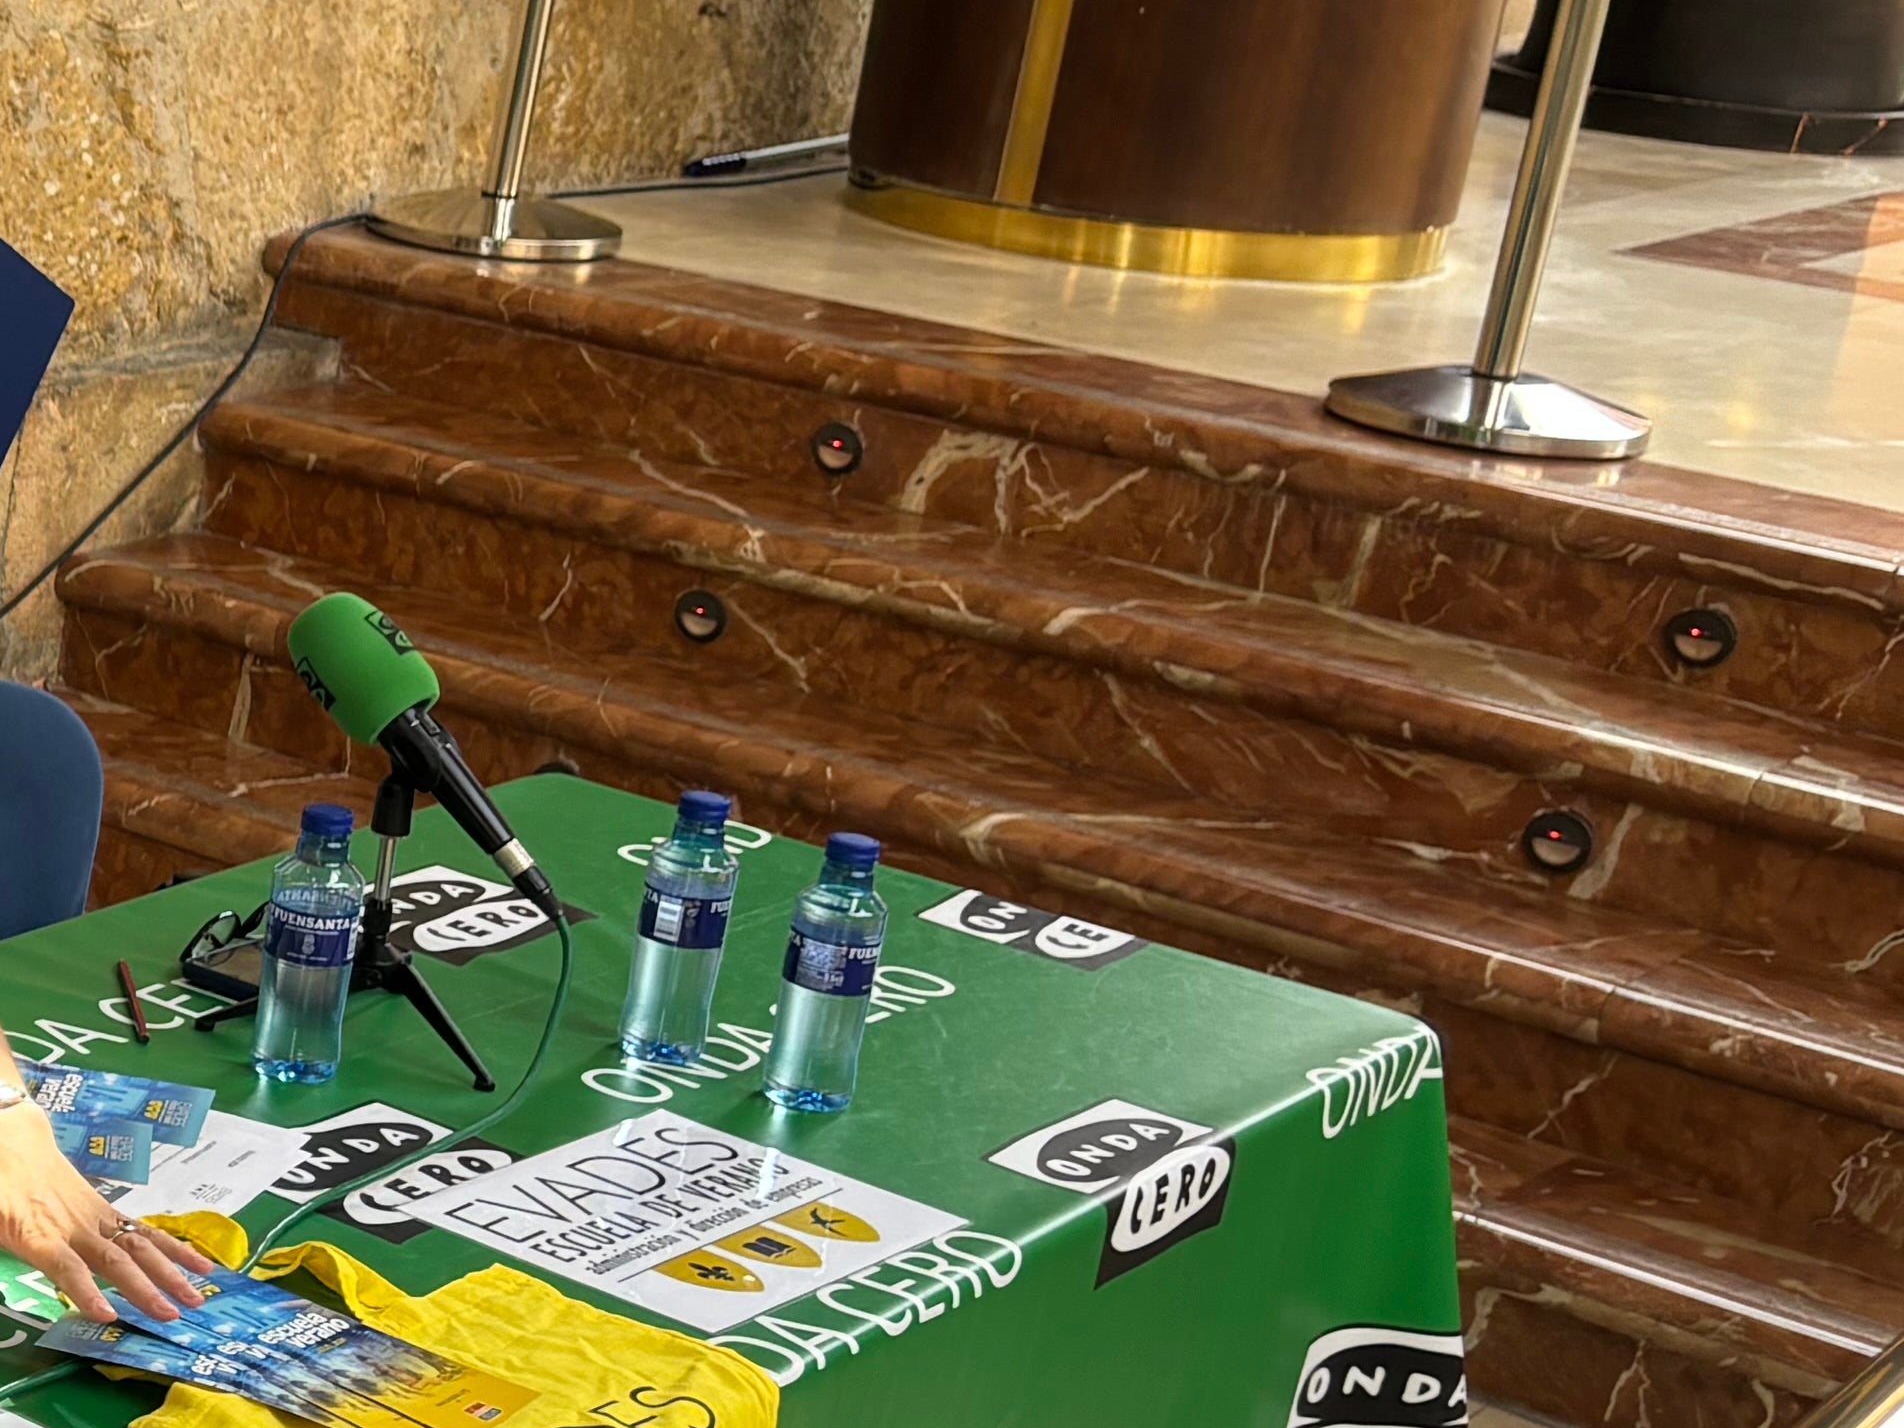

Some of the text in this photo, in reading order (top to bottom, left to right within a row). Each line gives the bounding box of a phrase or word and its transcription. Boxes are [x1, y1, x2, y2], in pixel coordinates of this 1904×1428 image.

[433, 902, 541, 942] CERO
[1046, 1121, 1170, 1176] ONDA
[446, 1128, 740, 1242] EVADES
[530, 1157, 790, 1263] ESCUELA DE VERANO
[1129, 1158, 1217, 1234] CERO
[818, 1228, 1024, 1339] CERO
[257, 1311, 328, 1347] escuela
[286, 1315, 351, 1350] verano
[1306, 1365, 1467, 1409] ONDA
